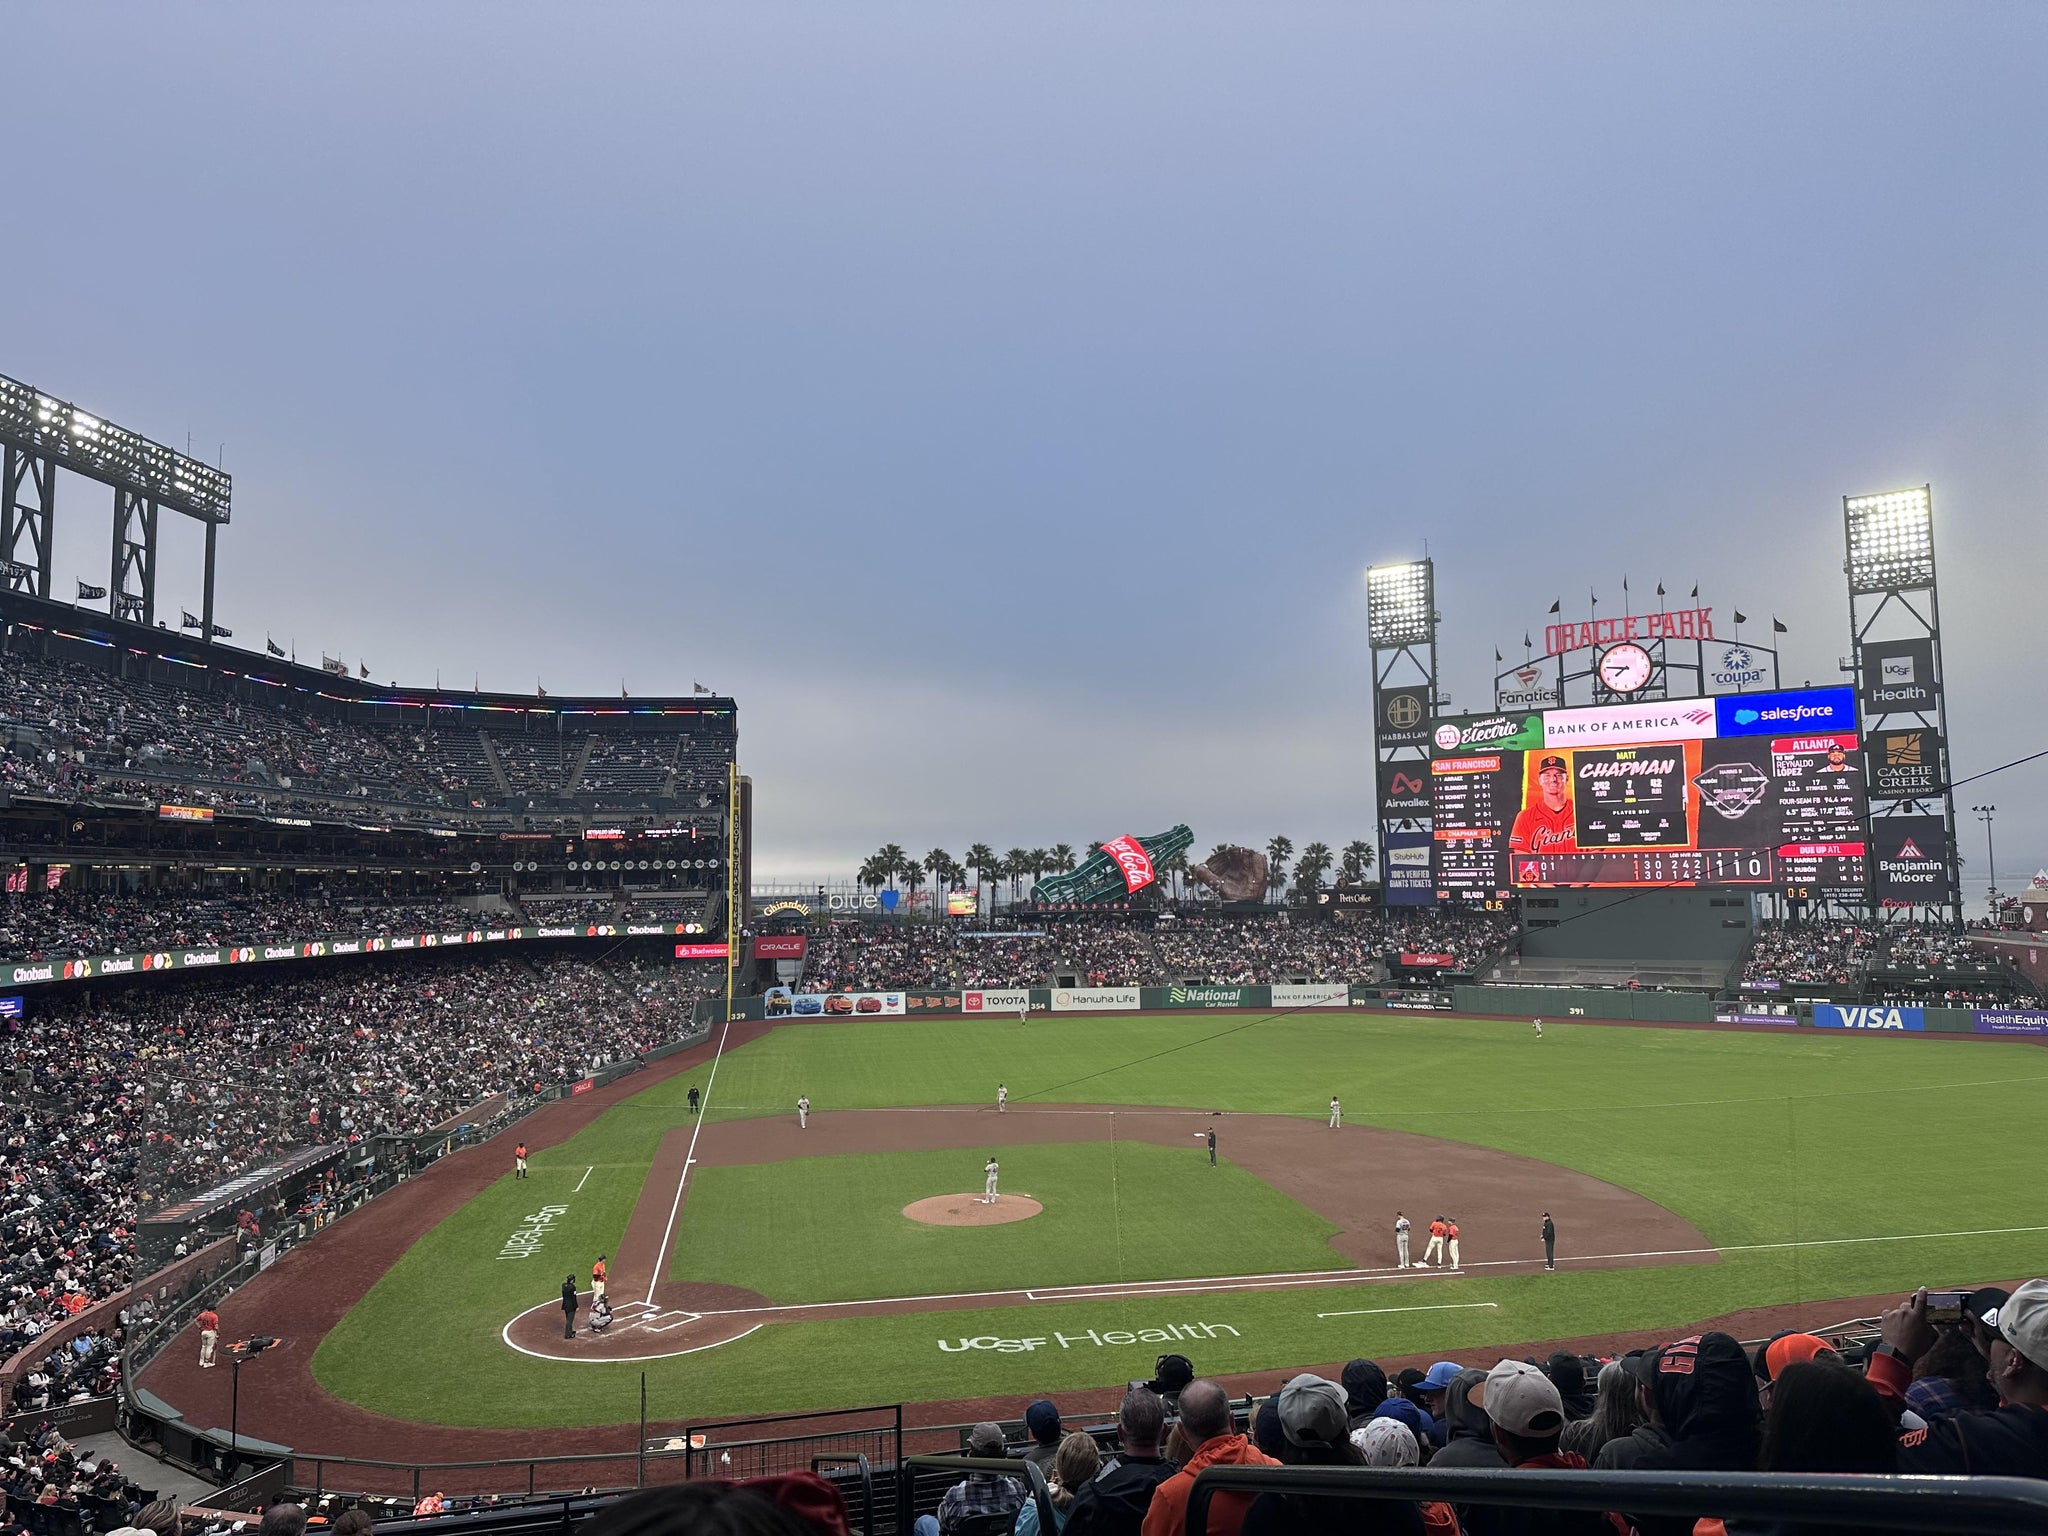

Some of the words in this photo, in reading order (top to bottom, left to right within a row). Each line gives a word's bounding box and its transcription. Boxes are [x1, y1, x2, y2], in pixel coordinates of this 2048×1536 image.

[1545, 616, 1638, 656] ORACLE
[1646, 607, 1715, 640] PARK
[1885, 665, 1911, 676] UCSF
[1716, 671, 1761, 685] coupa
[1499, 688, 1558, 705] Fanatics
[1873, 687, 1926, 701] Health
[1761, 706, 1833, 721] salesforce
[1548, 724, 1587, 735] BANK
[1591, 722, 1608, 732] OF
[1612, 718, 1679, 731] AMERICA
[1382, 732, 1411, 741] HABBAS
[1412, 731, 1428, 739] LAW
[1461, 721, 1518, 744] Electric
[1793, 738, 1835, 751] ATLANTA
[1616, 751, 1637, 760] MATT
[1435, 762, 1451, 771] SAN
[1452, 760, 1497, 770] FRANCISCO
[1578, 759, 1676, 778] CHAPMAN
[1776, 759, 1814, 769] REYNALDO
[1776, 767, 1803, 777] LÓPEZ
[1877, 765, 1933, 777] CACHE
[1879, 776, 1932, 787] CREEK
[1385, 799, 1430, 808] Airwallex
[1800, 846, 1816, 855] DUE
[1816, 846, 1827, 854] UP
[1394, 852, 1425, 861] StubHub
[1541, 862, 1547, 870] 0
[1550, 862, 1555, 871] 1
[1633, 860, 1639, 870] 1
[1644, 860, 1651, 870] 3
[1655, 860, 1662, 869] 0
[1671, 860, 1678, 869] 2
[1682, 860, 1690, 869] 4
[1694, 859, 1701, 869] 2
[1716, 859, 1723, 876] 1
[1733, 859, 1741, 876] 1
[1749, 859, 1761, 876] 0
[1880, 860, 1943, 873] Benjamin
[1391, 871, 1405, 879] 100%
[1405, 870, 1429, 878] VERIFIED
[1542, 872, 1547, 880] 1
[1633, 870, 1639, 880] 1
[1644, 870, 1651, 880] 3
[1655, 870, 1662, 879] 0
[1672, 870, 1678, 879] 1
[1682, 870, 1690, 879] 4
[1694, 870, 1701, 879] 2
[1889, 872, 1934, 883] Moore
[1389, 879, 1409, 888] GIANTS
[1409, 879, 1432, 888] TICKETS
[828, 889, 878, 909] blue
[1354, 893, 1372, 903] Coffee
[1881, 898, 1914, 908] Coors
[1915, 900, 1943, 908] LIGHT
[763, 900, 812, 917] Ghirardelli
[1486, 900, 1503, 910] 0:15
[691, 947, 728, 955] Budweiser
[760, 943, 801, 951] ORACLE
[1072, 994, 1114, 1004] Hanwha
[1116, 994, 1136, 1003] Life
[1187, 988, 1241, 1001] National
[986, 997, 1026, 1005] TOYOTA
[1218, 1000, 1239, 1008] Rental
[1352, 998, 1366, 1006] 399
[1031, 1003, 1045, 1011] 354
[1569, 1007, 1584, 1015] 391
[731, 1012, 746, 1020] 339
[1833, 1007, 1904, 1029] VISA
[1981, 1013, 2048, 1028] HealthEquity
[574, 1082, 592, 1094] ORACLE
[496, 1223, 559, 1260] Health
[938, 1336, 1047, 1352] UCSF
[1053, 1322, 1241, 1348] Health
